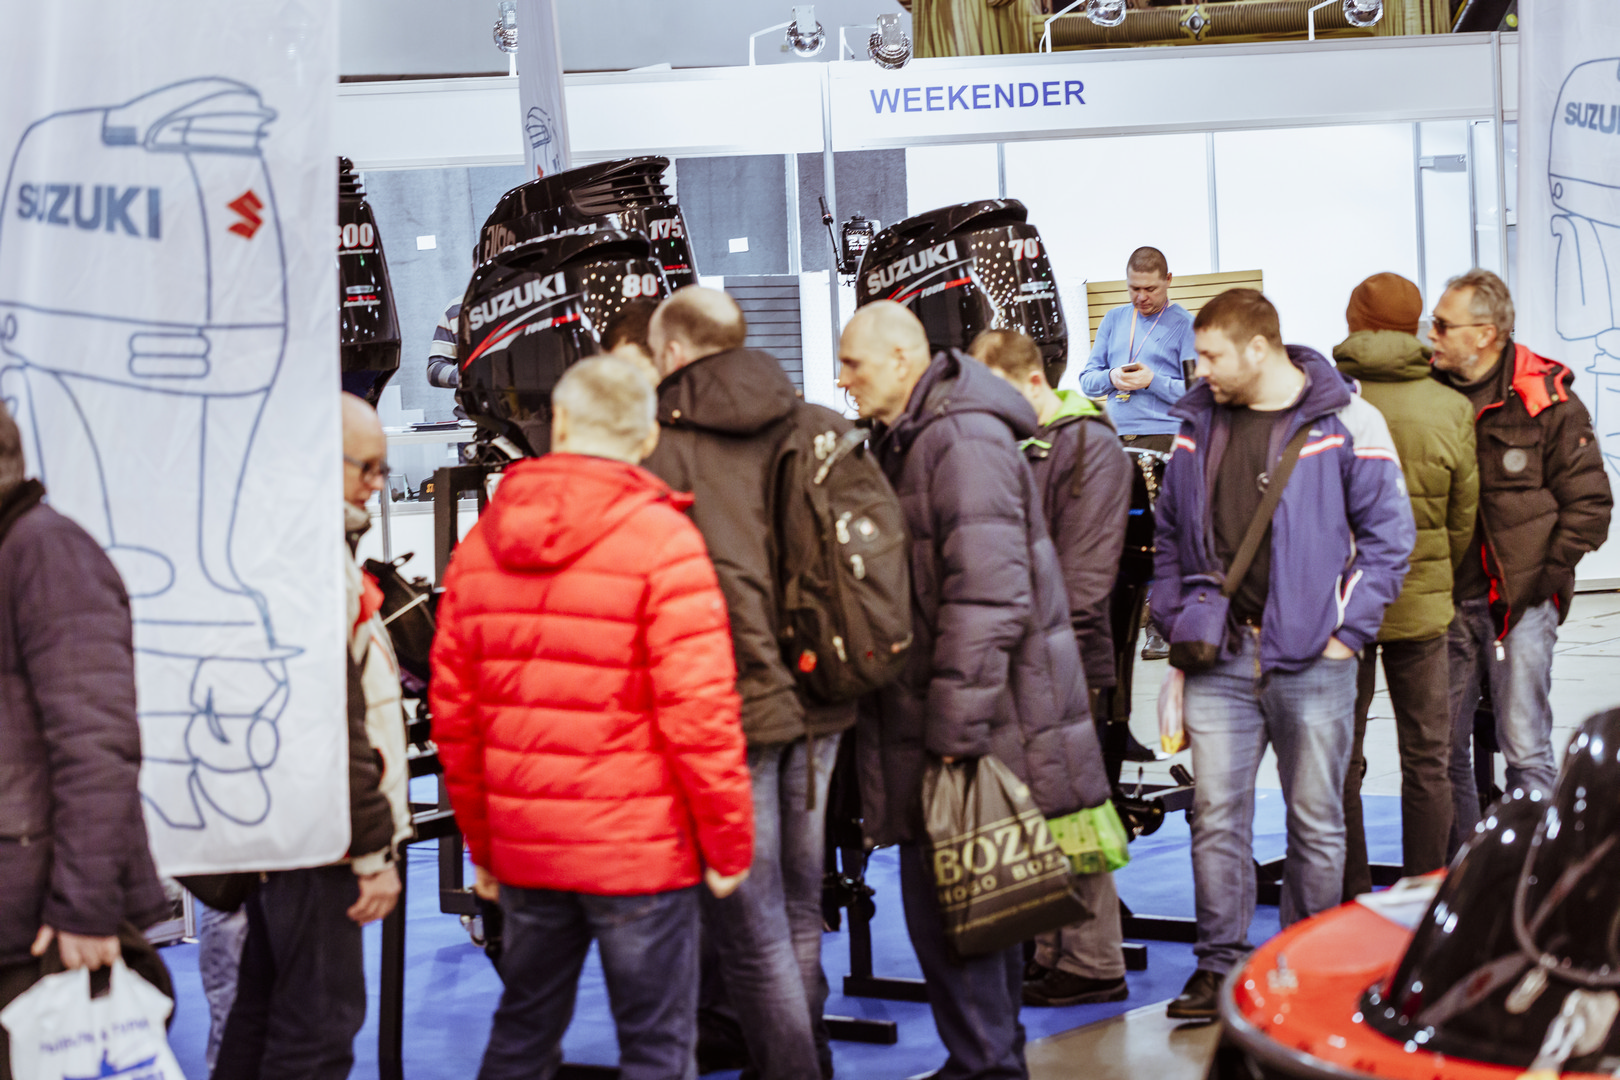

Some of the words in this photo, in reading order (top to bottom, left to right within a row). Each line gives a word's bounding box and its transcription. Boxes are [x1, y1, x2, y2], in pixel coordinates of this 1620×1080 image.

[870, 80, 1086, 114] WEEKENDER
[1564, 102, 1620, 135] SUZU
[649, 218, 683, 241] 175
[1008, 237, 1039, 261] 70
[866, 239, 959, 296] SUZUKI
[468, 271, 567, 331] SUZUKI
[621, 273, 659, 298] 80
[933, 814, 1057, 886] BOZZ
